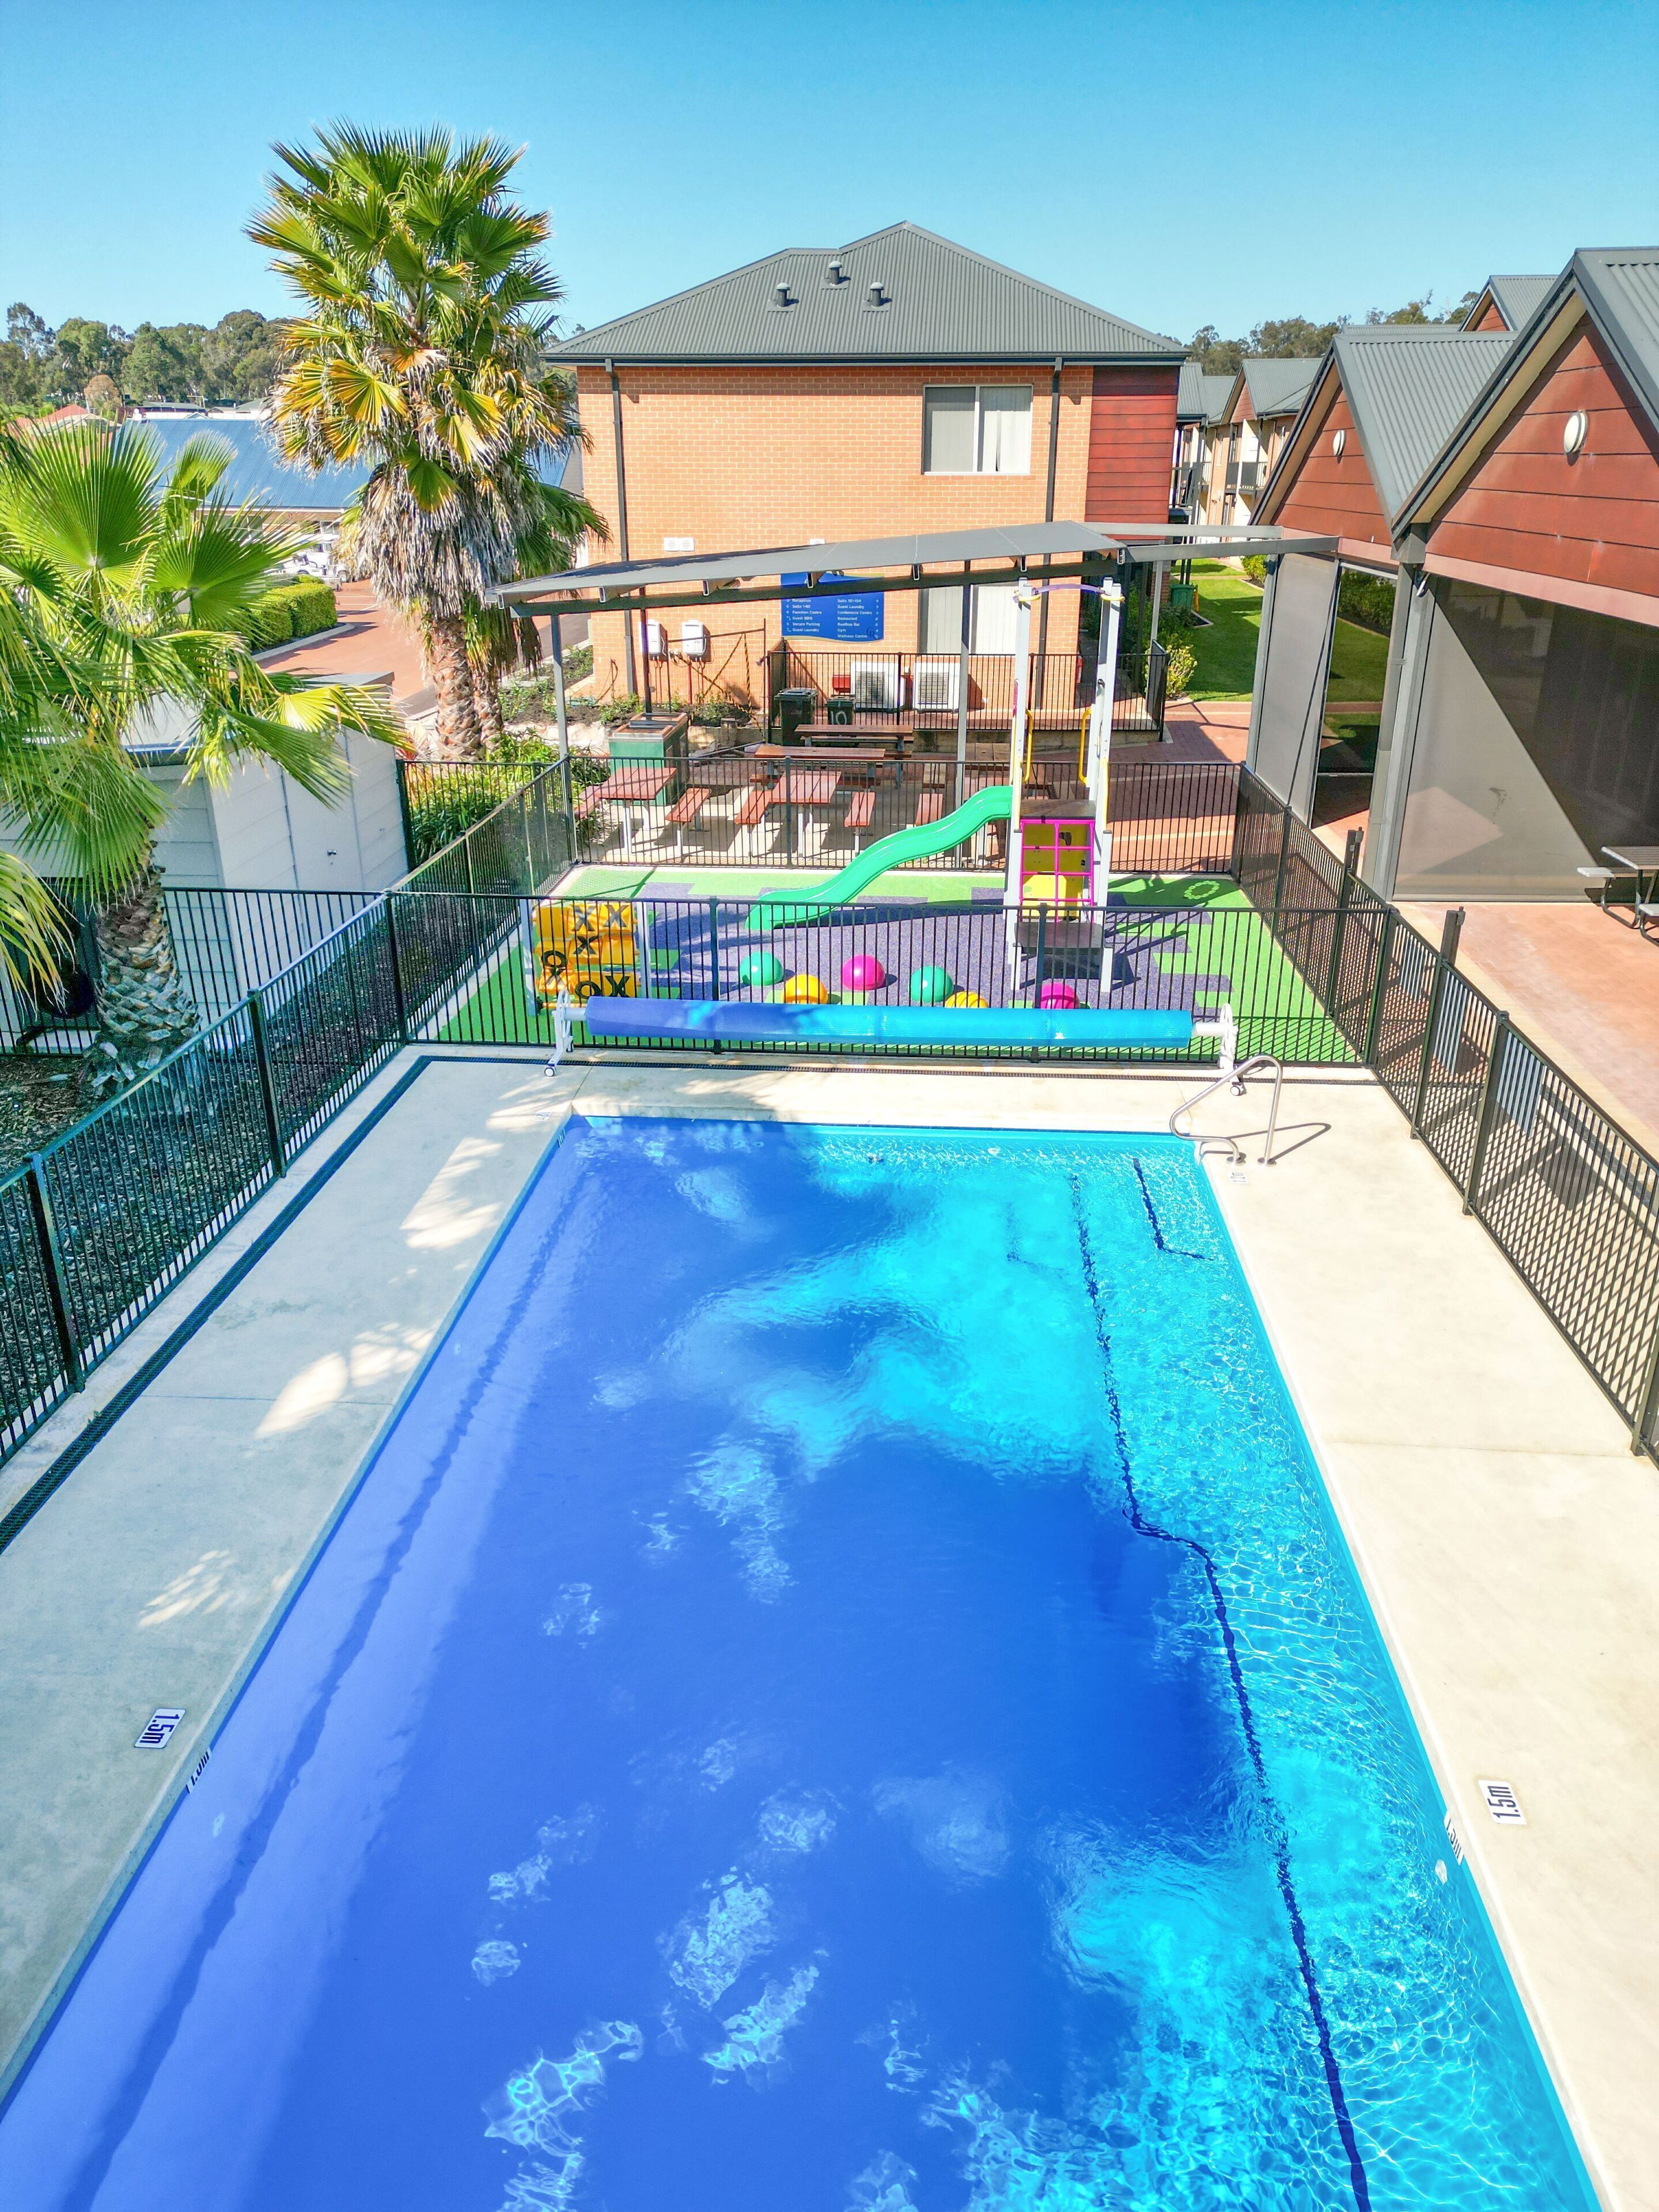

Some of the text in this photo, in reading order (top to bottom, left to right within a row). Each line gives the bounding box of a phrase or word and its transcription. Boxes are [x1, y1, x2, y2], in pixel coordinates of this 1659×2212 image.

[831, 711, 847, 725] 10
[139, 1714, 180, 1744] 1.5m
[1487, 1786, 1521, 1818] 1.5m
